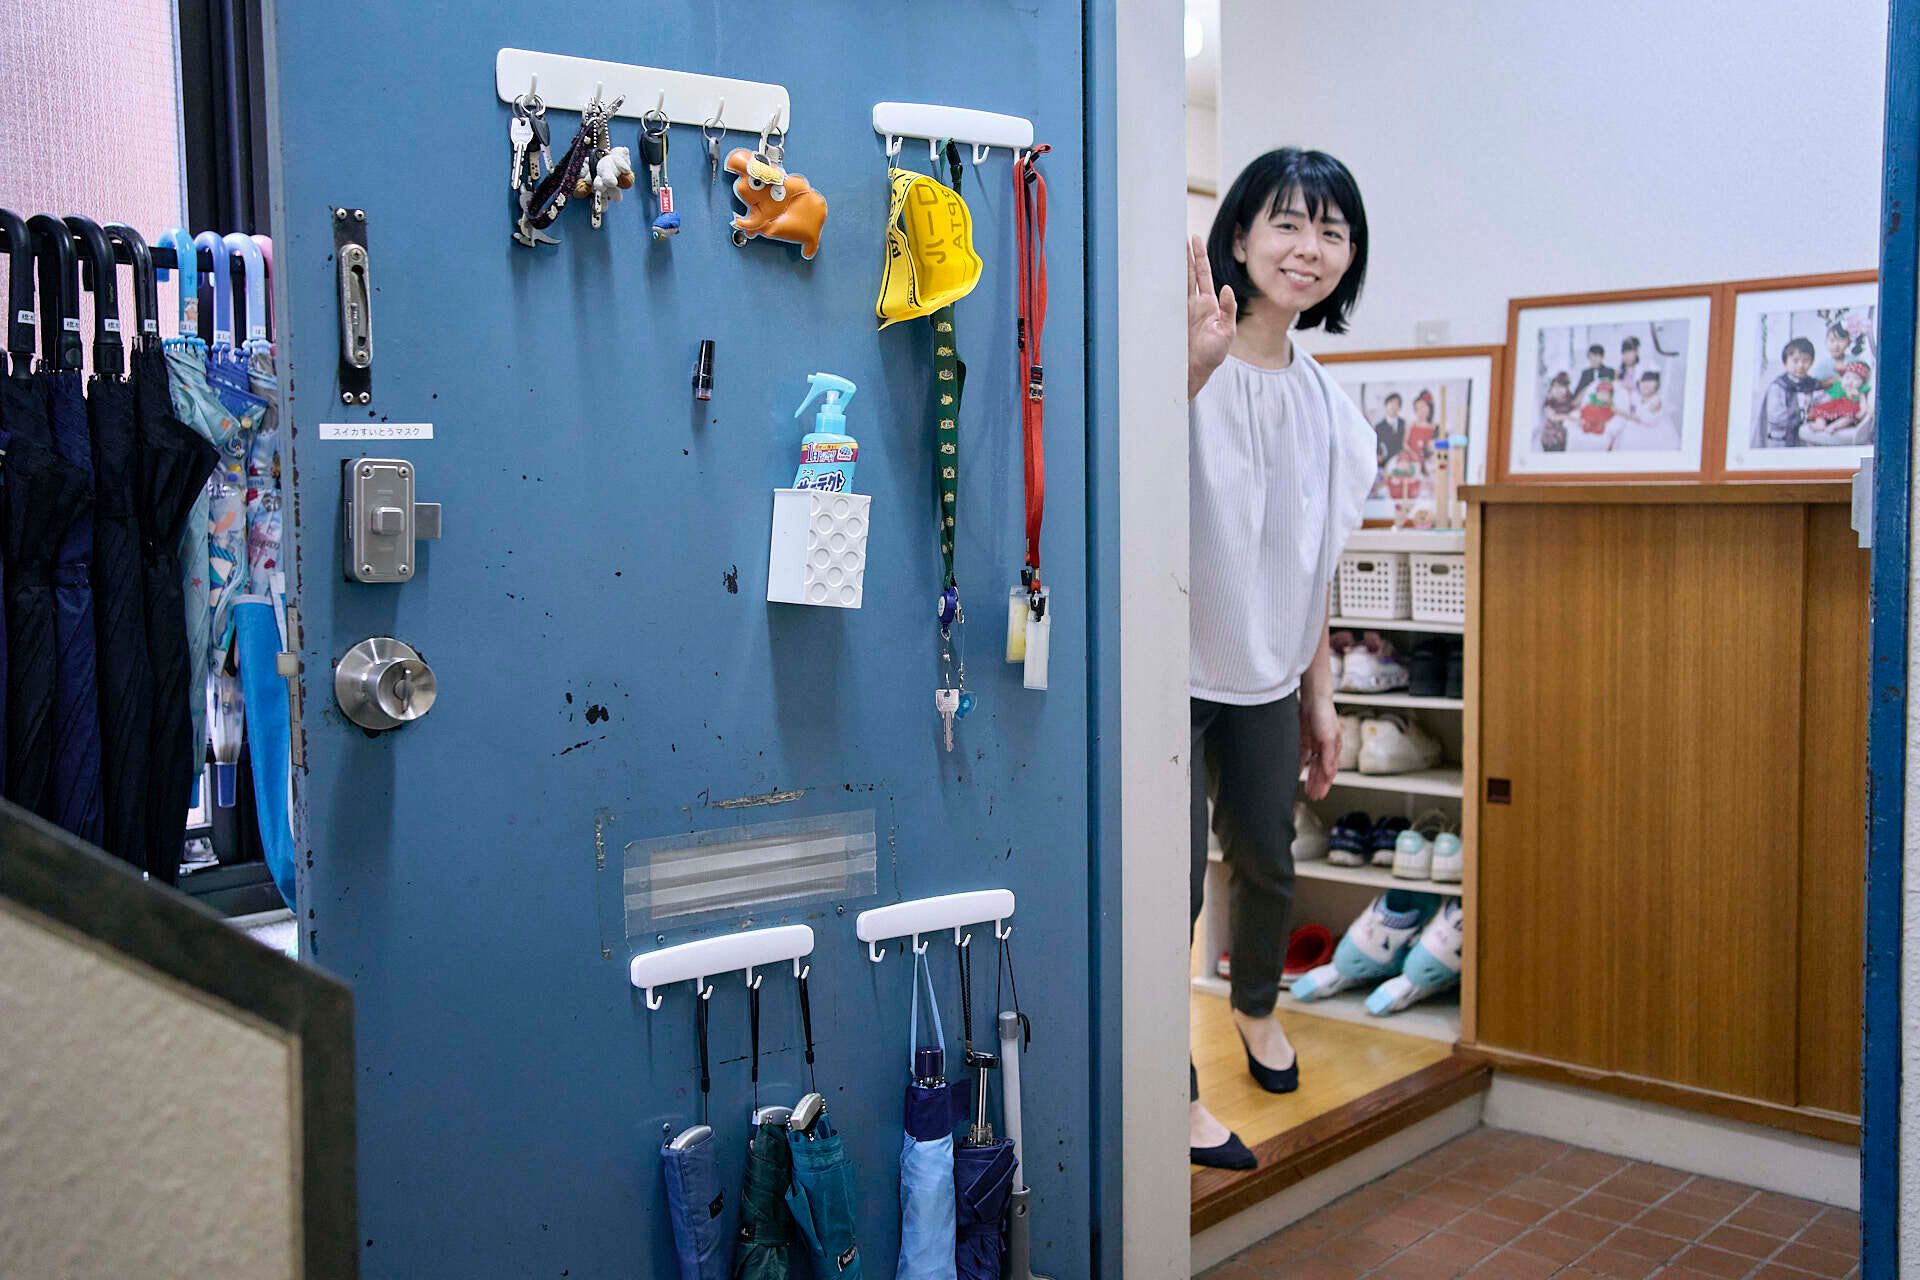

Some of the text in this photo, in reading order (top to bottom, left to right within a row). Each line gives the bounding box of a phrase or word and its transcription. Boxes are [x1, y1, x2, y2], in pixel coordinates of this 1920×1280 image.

[333, 427, 421, 437] スイカすいとうマスク
